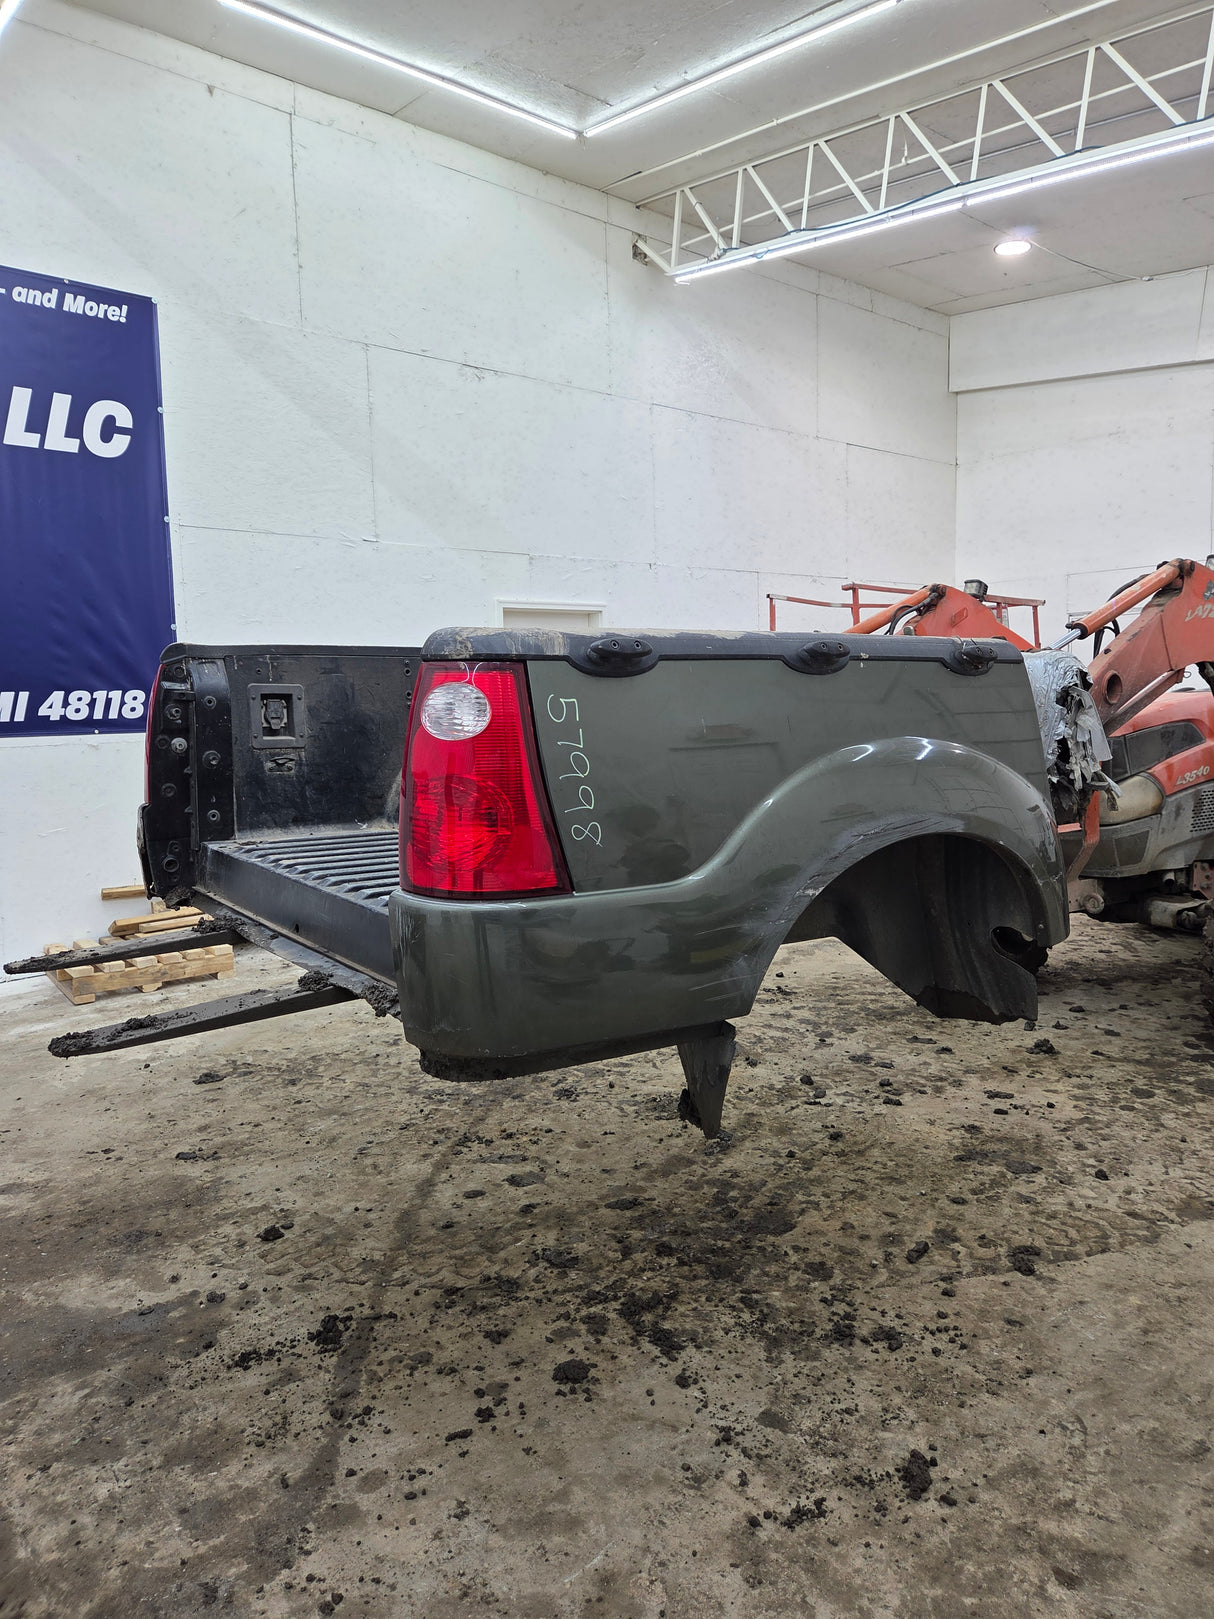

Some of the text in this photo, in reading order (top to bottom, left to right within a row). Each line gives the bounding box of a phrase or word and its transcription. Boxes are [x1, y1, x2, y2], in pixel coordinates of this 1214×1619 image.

[12, 286, 58, 309] and
[63, 293, 128, 323] More!
[3, 386, 133, 458] LLC
[38, 690, 146, 721] 48118
[547, 694, 603, 847] 57998
[1176, 765, 1211, 785] L3540
